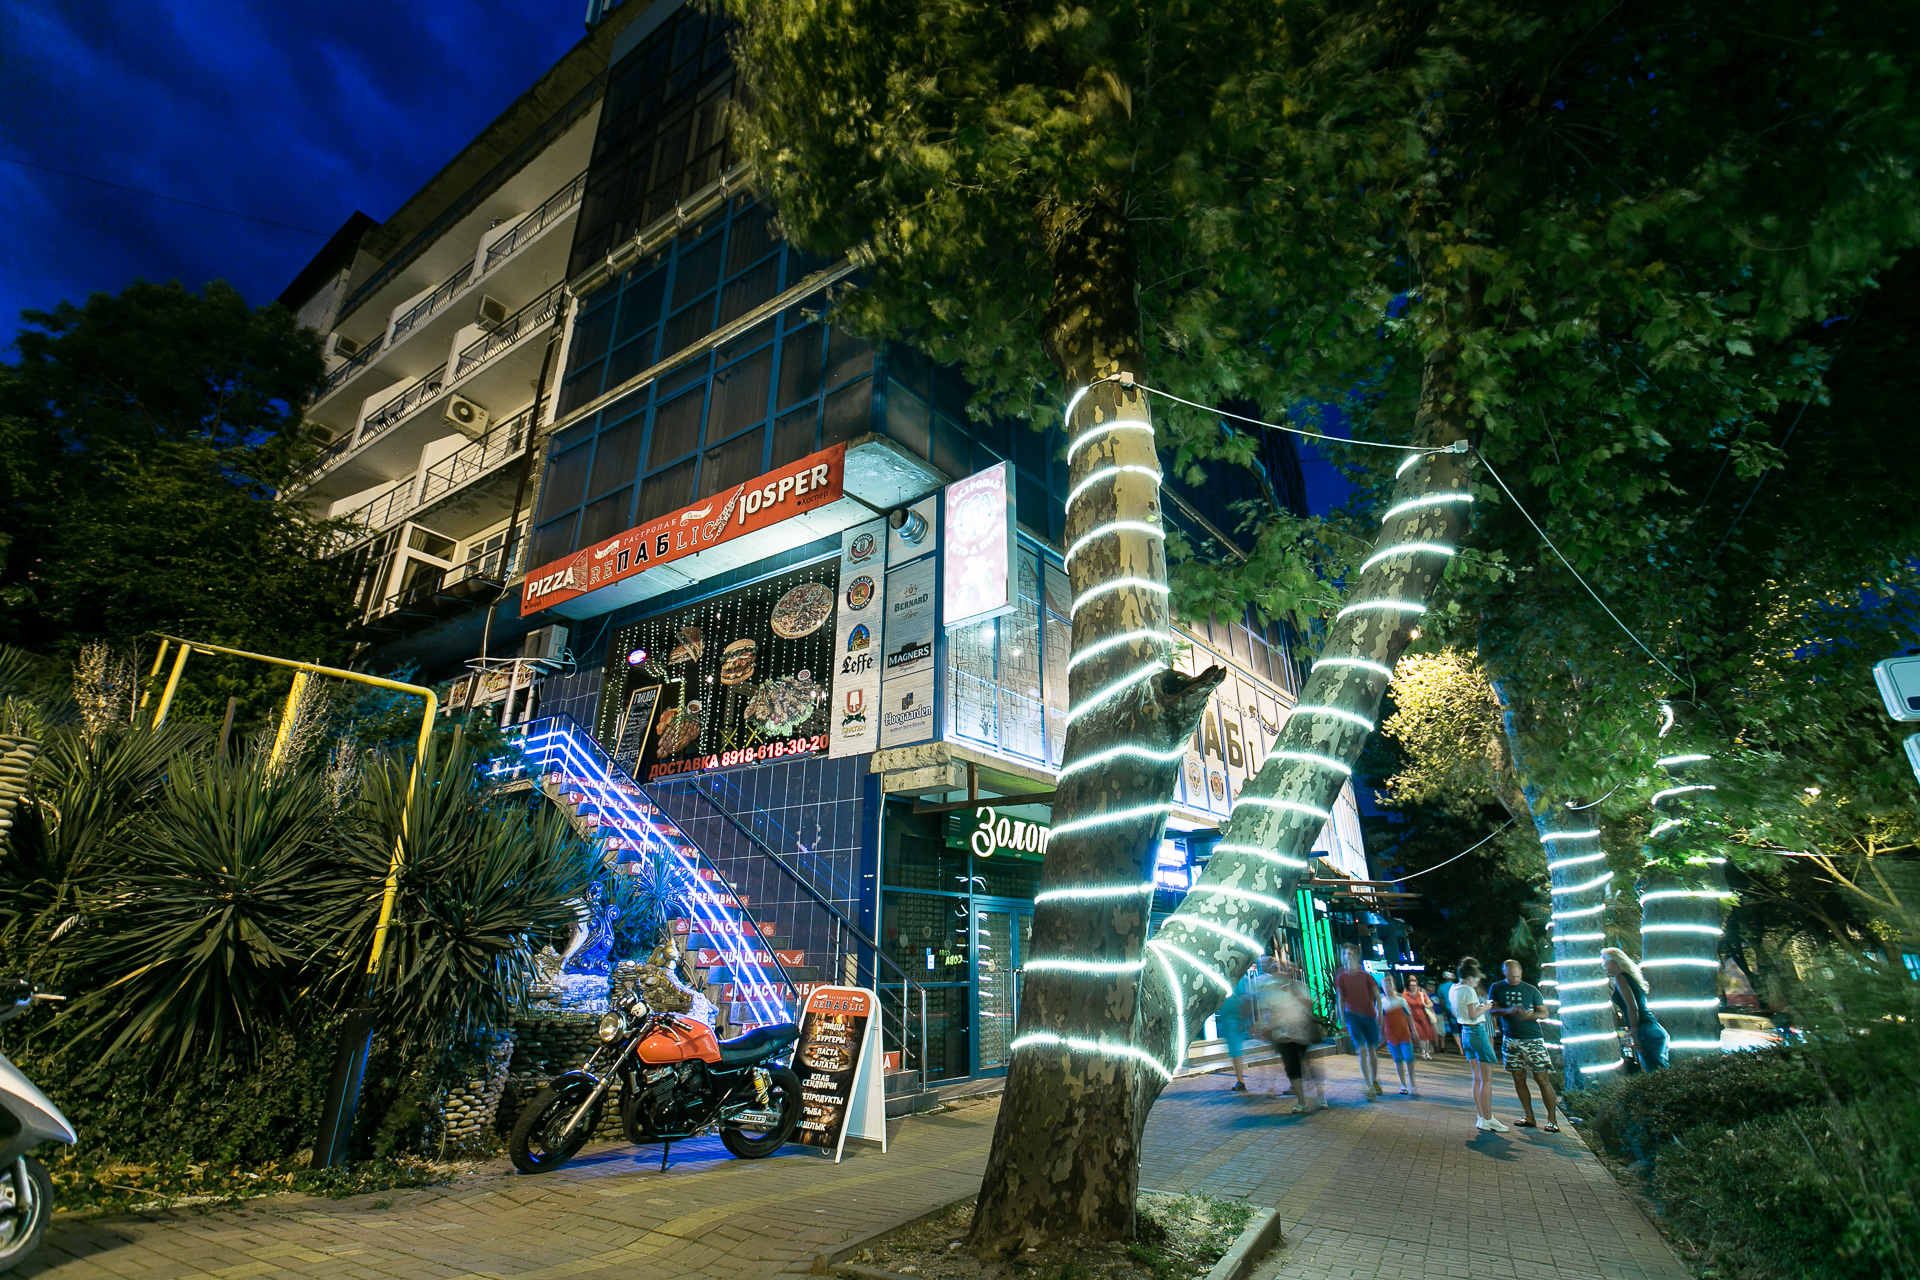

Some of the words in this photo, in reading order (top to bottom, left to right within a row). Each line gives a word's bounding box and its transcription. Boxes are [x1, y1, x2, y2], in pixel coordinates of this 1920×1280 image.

[738, 463, 829, 525] JOSPER
[801, 490, 829, 507] Хоспер
[949, 478, 1001, 507] ГАСТРОПАБ
[624, 518, 677, 545] ГАСТРОПАБ
[527, 566, 574, 601] PIZZA
[894, 593, 928, 612] BERNARD
[840, 652, 873, 676] Leffe
[888, 645, 930, 666] MAGNERS
[884, 704, 932, 726] Hoegaarden
[648, 754, 718, 780] ДОСТАВКА
[721, 734, 829, 766] 8918-618-30-20
[615, 819, 656, 833] СААТ
[724, 951, 780, 963] ШШЛЫ
[822, 1022, 845, 1032] ПИЦЦА
[816, 1034, 846, 1044] БУРГЕРЫ
[816, 1047, 839, 1057] ПАСТА
[810, 1059, 839, 1070] САЛАТЫ
[802, 1079, 838, 1090] СЕНДВИЧИ
[810, 1072, 830, 1082] КЛАБ
[803, 1106, 822, 1116] РЫБА
